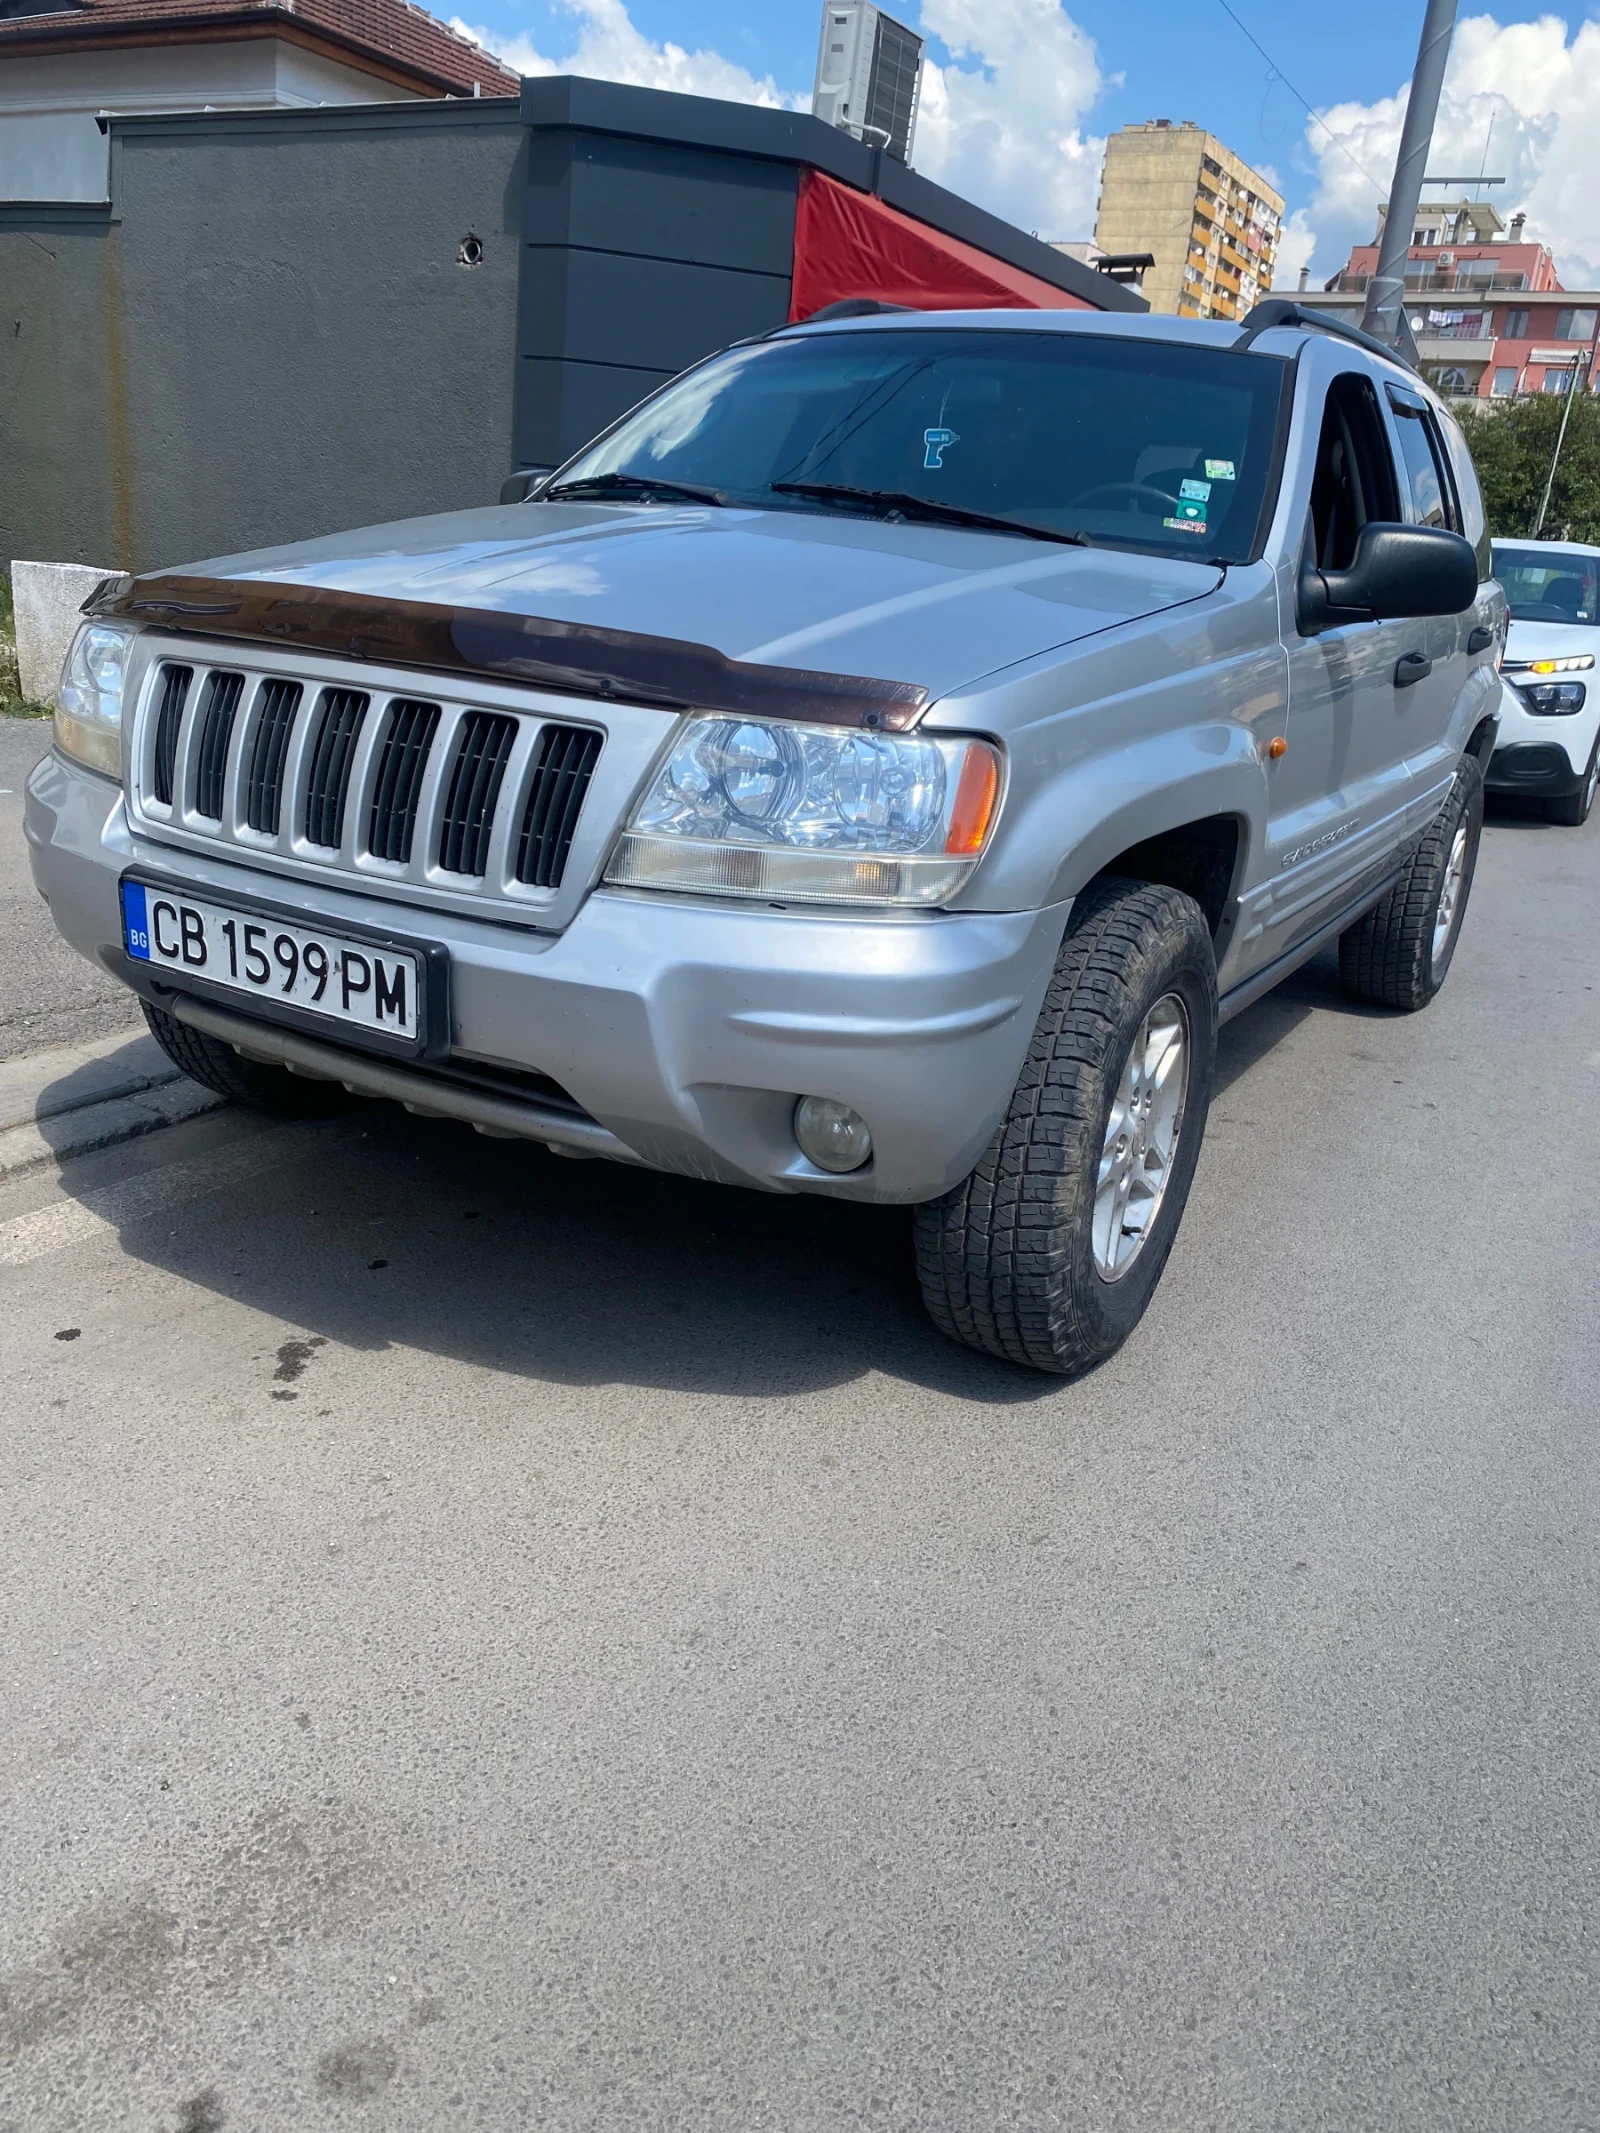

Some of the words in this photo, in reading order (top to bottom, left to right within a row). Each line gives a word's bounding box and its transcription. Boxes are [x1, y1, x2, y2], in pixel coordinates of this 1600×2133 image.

[130, 928, 148, 949] BG
[153, 899, 208, 967] CB
[221, 918, 329, 1002] 1599
[341, 949, 407, 1026] PM
